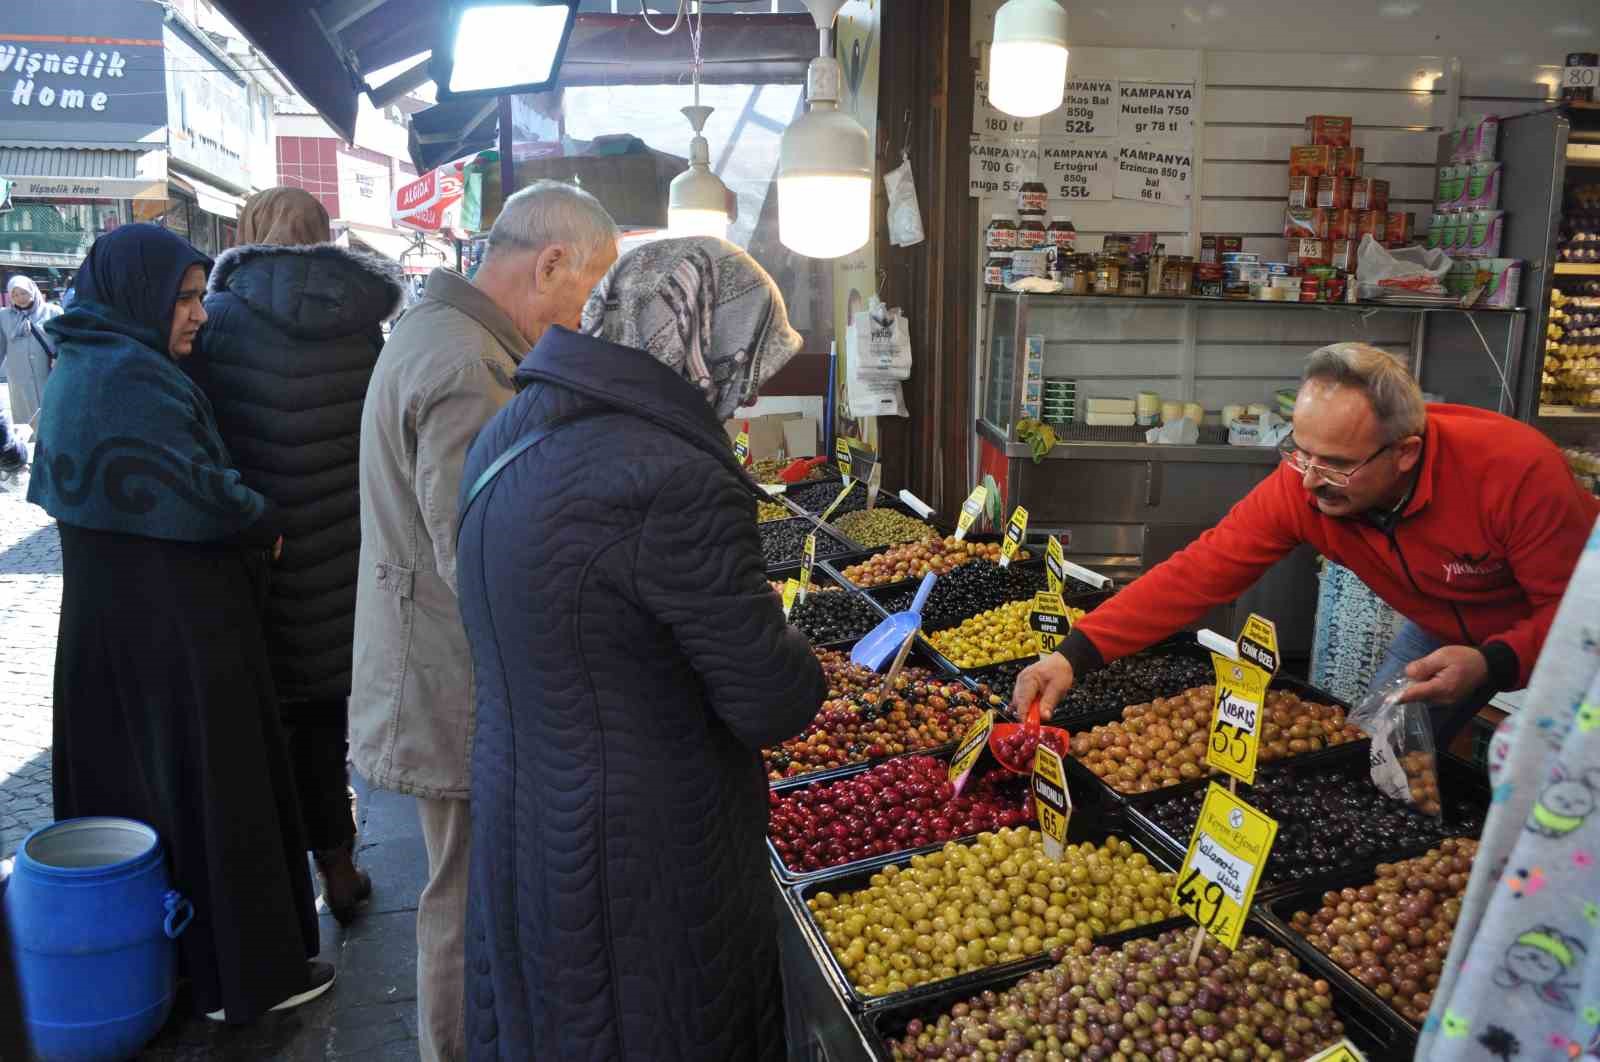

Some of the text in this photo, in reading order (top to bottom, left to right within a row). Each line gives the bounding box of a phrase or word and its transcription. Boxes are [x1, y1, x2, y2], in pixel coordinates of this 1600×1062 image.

[0, 45, 126, 78] Vişnelik
[1569, 69, 1593, 85] 80
[1065, 82, 1112, 92] MPANYA
[1120, 87, 1192, 100] KAMPANYA
[12, 79, 108, 111] Home
[1092, 95, 1110, 105] Bal
[1066, 108, 1094, 119] 850g
[1121, 104, 1190, 115] Nutella 750
[985, 118, 1008, 131] 180
[1135, 121, 1178, 133] gr 78 tl
[970, 145, 1037, 160] KAMPANYA
[1044, 148, 1108, 159] KAMPANYA
[1120, 147, 1190, 167] KAMPANYA
[981, 160, 1001, 172] 700
[1053, 161, 1098, 173] Ertuğrul
[1120, 161, 1159, 175] Erzincan
[1179, 172, 1186, 181] g
[1063, 174, 1087, 184] 850g
[1145, 177, 1160, 187] bal
[1041, 634, 1056, 651] 90
[1216, 687, 1256, 729] KIBRIS
[1212, 719, 1251, 764] 55
[1043, 807, 1057, 837] 65
[1177, 867, 1226, 929] 49
